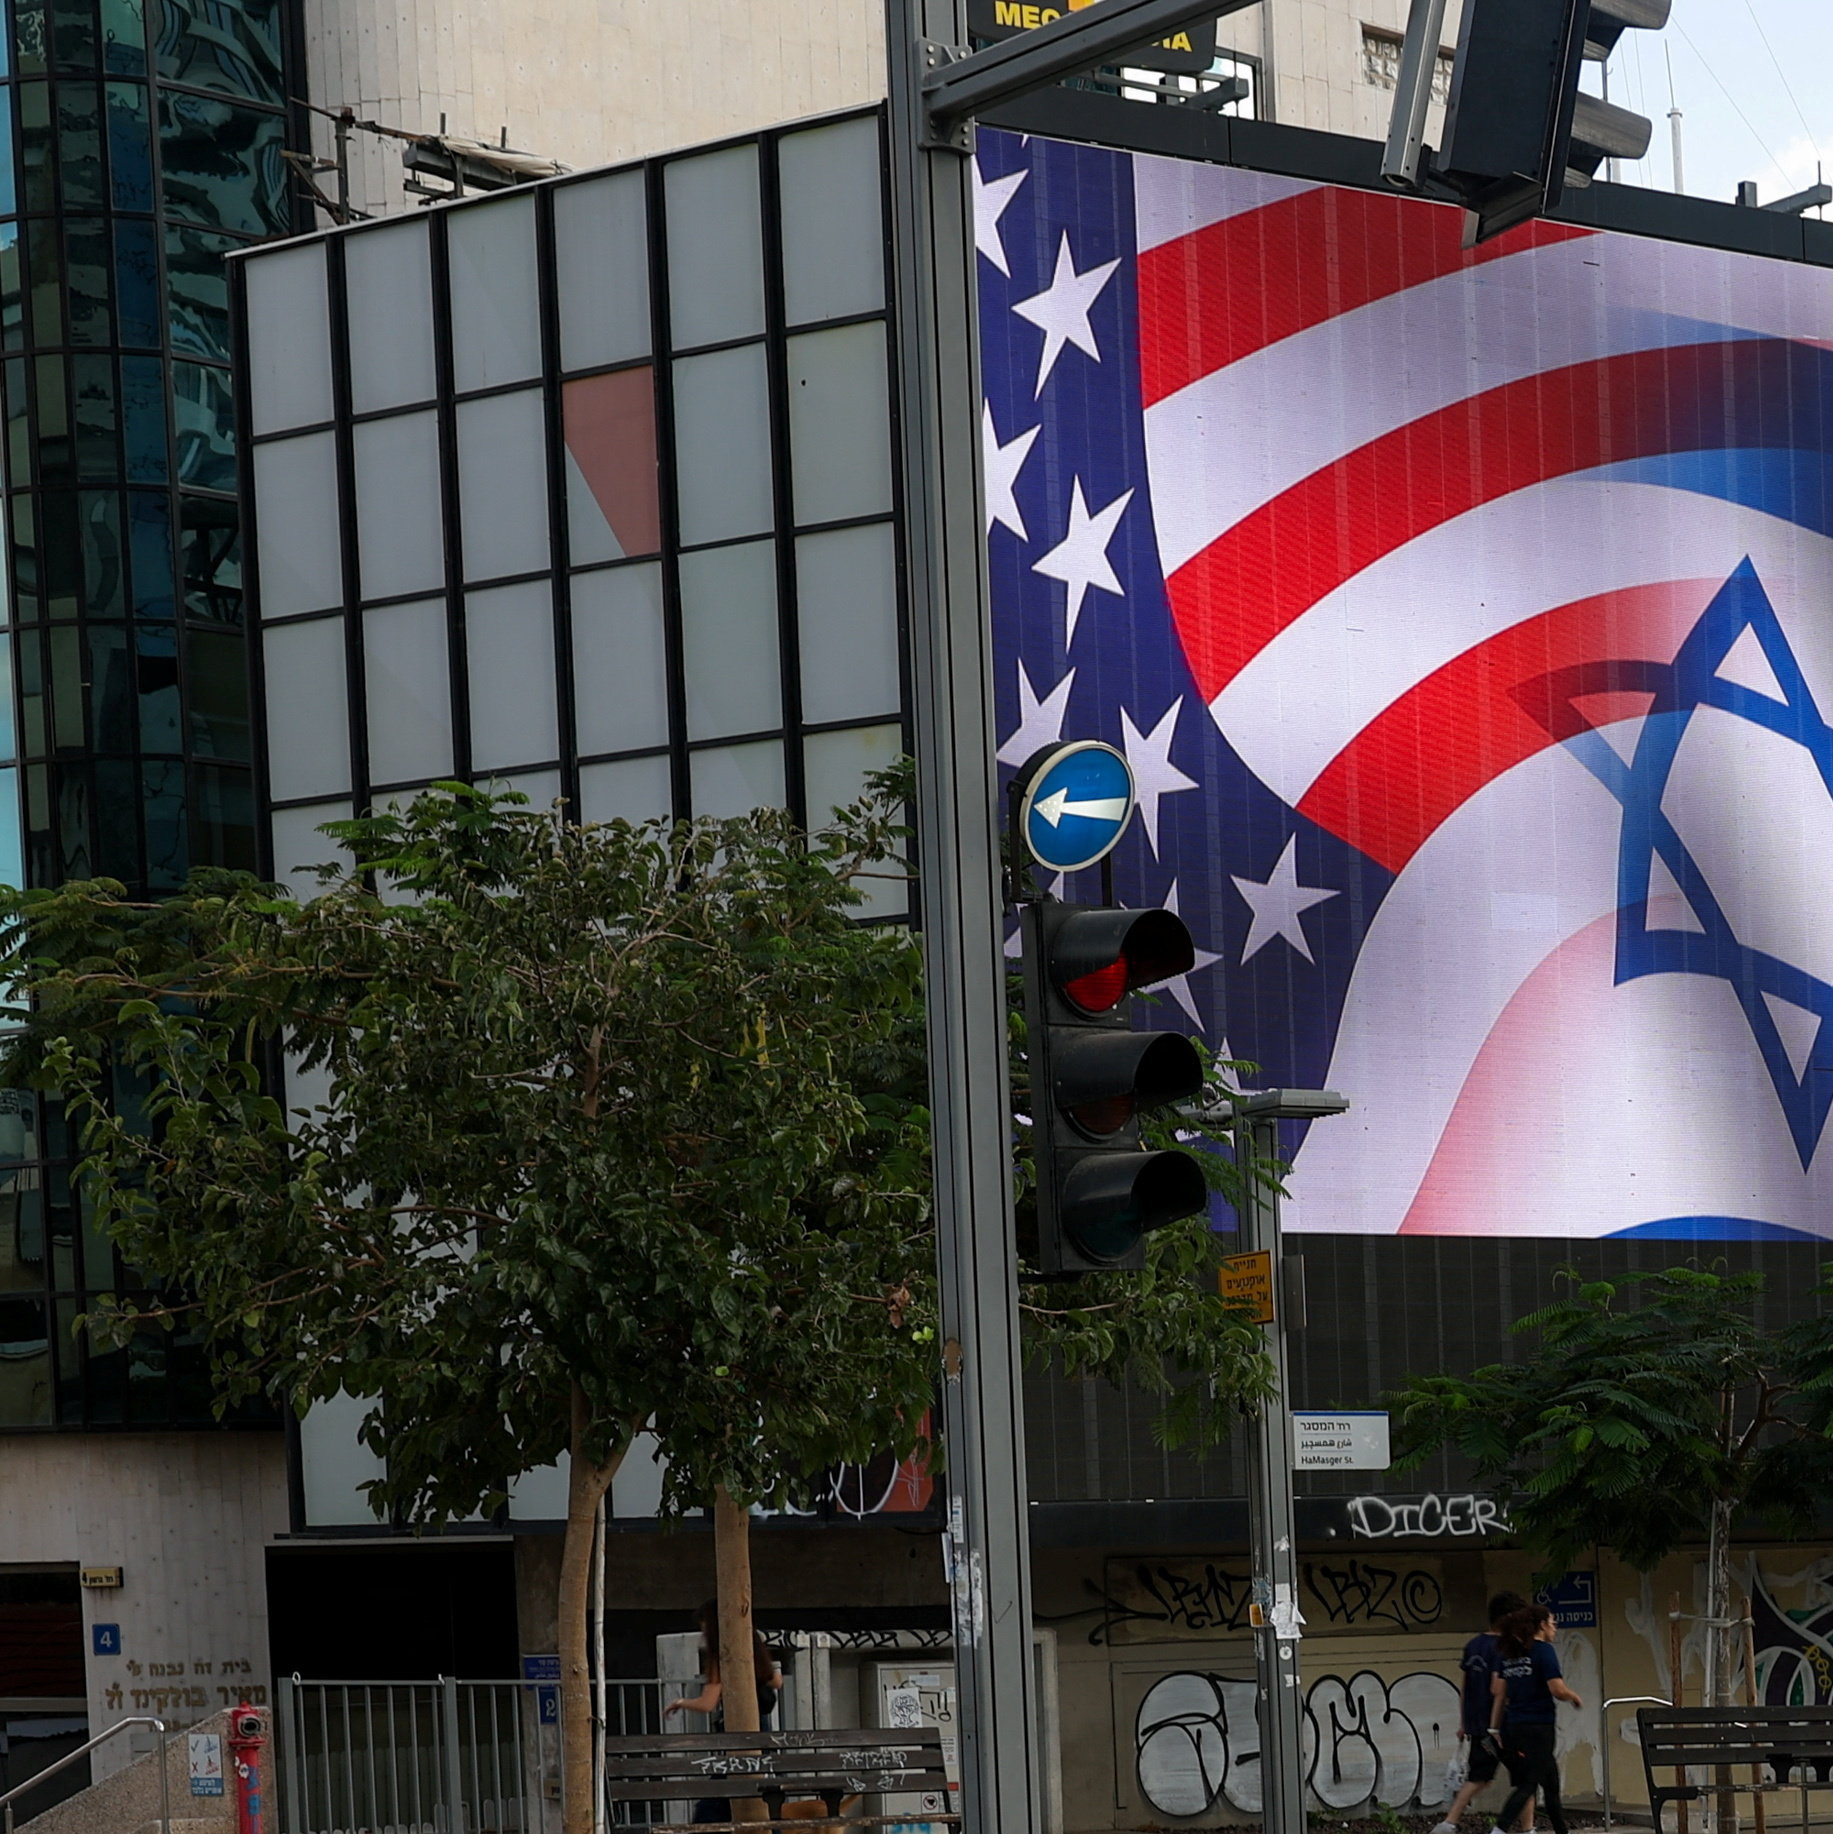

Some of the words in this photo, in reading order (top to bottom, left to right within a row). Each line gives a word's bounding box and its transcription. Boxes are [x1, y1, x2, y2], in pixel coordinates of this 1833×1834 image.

[1300, 1421, 1335, 1431] המסגר
[1301, 1455, 1342, 1466] HaMasger
[1566, 1611, 1594, 1622] כניסה
[100, 1631, 113, 1648] 4
[149, 1661, 185, 1677] נבנה
[193, 1661, 213, 1675] זה
[221, 1659, 252, 1675] בית
[216, 1685, 267, 1705] מאיר
